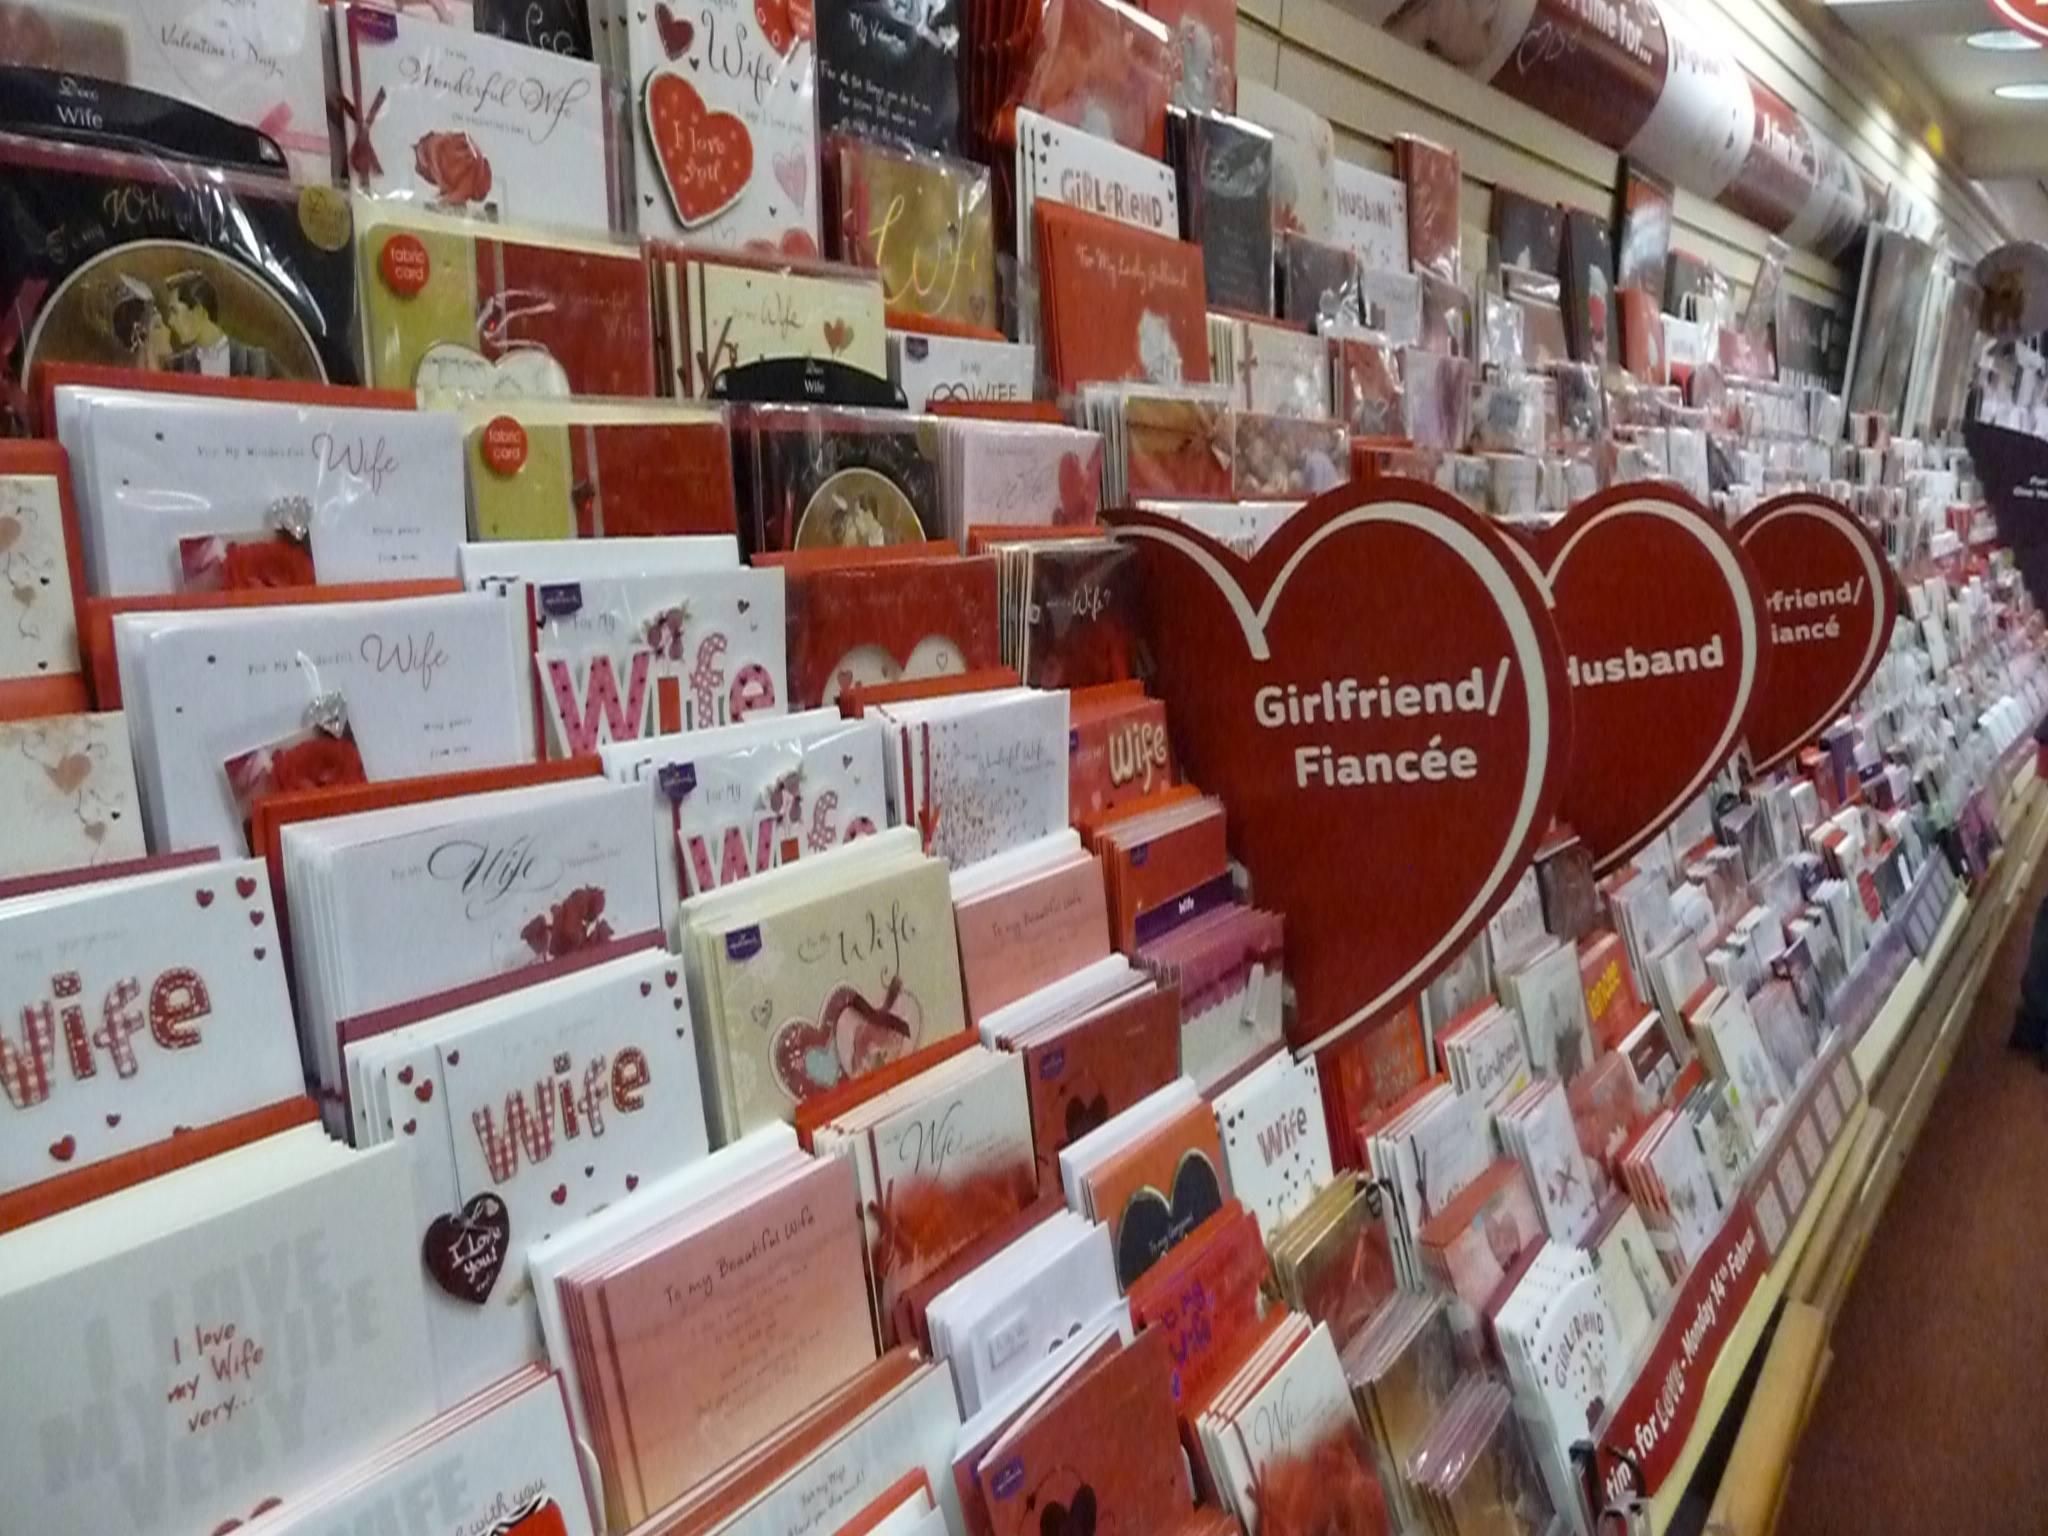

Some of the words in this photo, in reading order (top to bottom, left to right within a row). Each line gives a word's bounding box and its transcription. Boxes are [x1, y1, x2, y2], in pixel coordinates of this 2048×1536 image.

[701, 9, 780, 107] Wife
[56, 104, 104, 129] Wife
[390, 247, 425, 264] fabric
[394, 265, 424, 282] card
[804, 379, 825, 395] Wife
[311, 432, 400, 496] Wife
[1765, 576, 1865, 613] friend/
[1771, 613, 1841, 645] iancé
[359, 631, 449, 692] Wife
[1253, 655, 1512, 729] Girlfriend/
[1108, 723, 1168, 796] Wife
[1294, 733, 1479, 790] Fiancée
[427, 833, 565, 922] Wife
[471, 1045, 651, 1186] Wife
[1256, 1106, 1308, 1168] Wife
[664, 1282, 683, 1308] To
[688, 1273, 714, 1298] my
[715, 1226, 782, 1281] Beautiful
[166, 1374, 201, 1403] my
[210, 1337, 265, 1383] Wife
[173, 1337, 182, 1365] I
[195, 1322, 237, 1357] love
[1634, 1422, 1659, 1460] for
